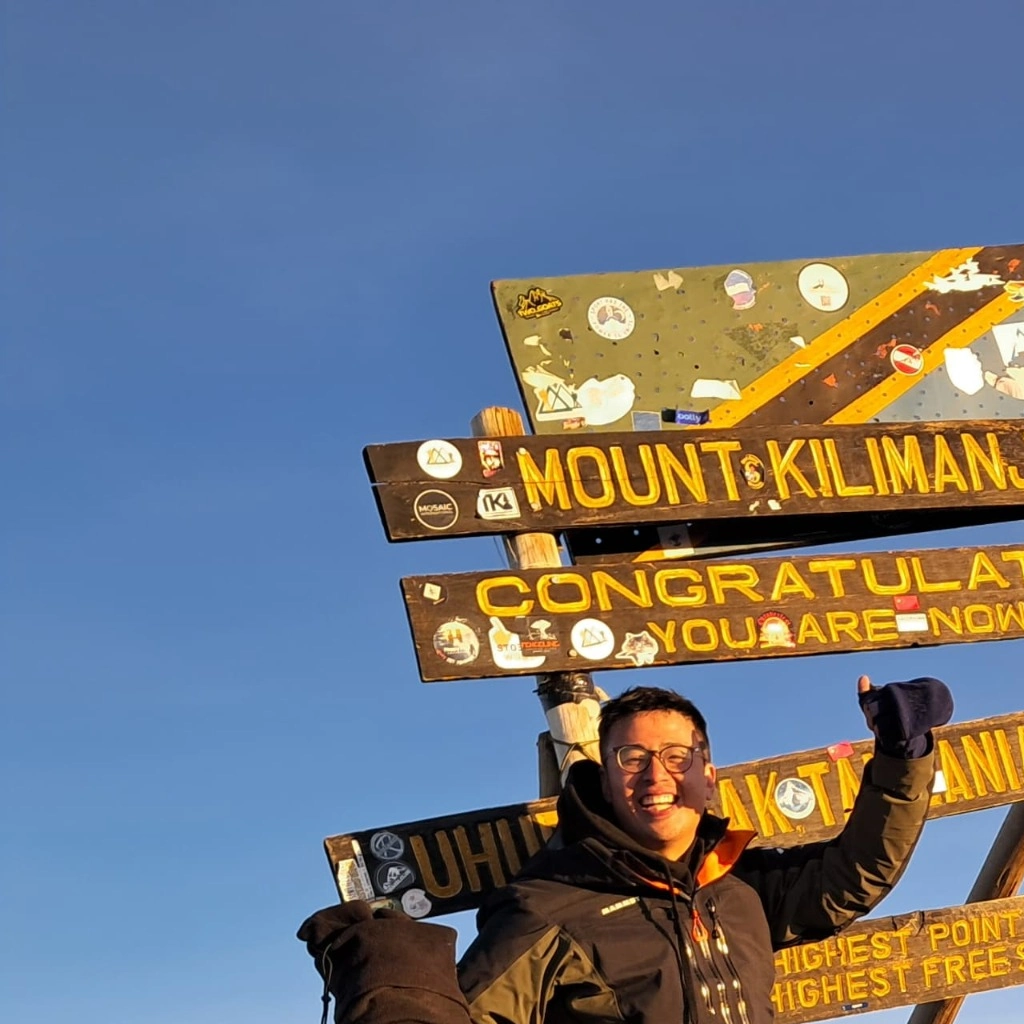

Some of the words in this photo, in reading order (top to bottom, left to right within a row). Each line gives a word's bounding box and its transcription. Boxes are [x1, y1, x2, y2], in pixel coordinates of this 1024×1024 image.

[516, 441, 742, 512] MOUNT
[418, 503, 453, 513] MOSAIC
[647, 617, 757, 653] YOU
[798, 609, 899, 644] ARE
[927, 910, 1021, 951] POINT
[922, 946, 1010, 987] FREE
